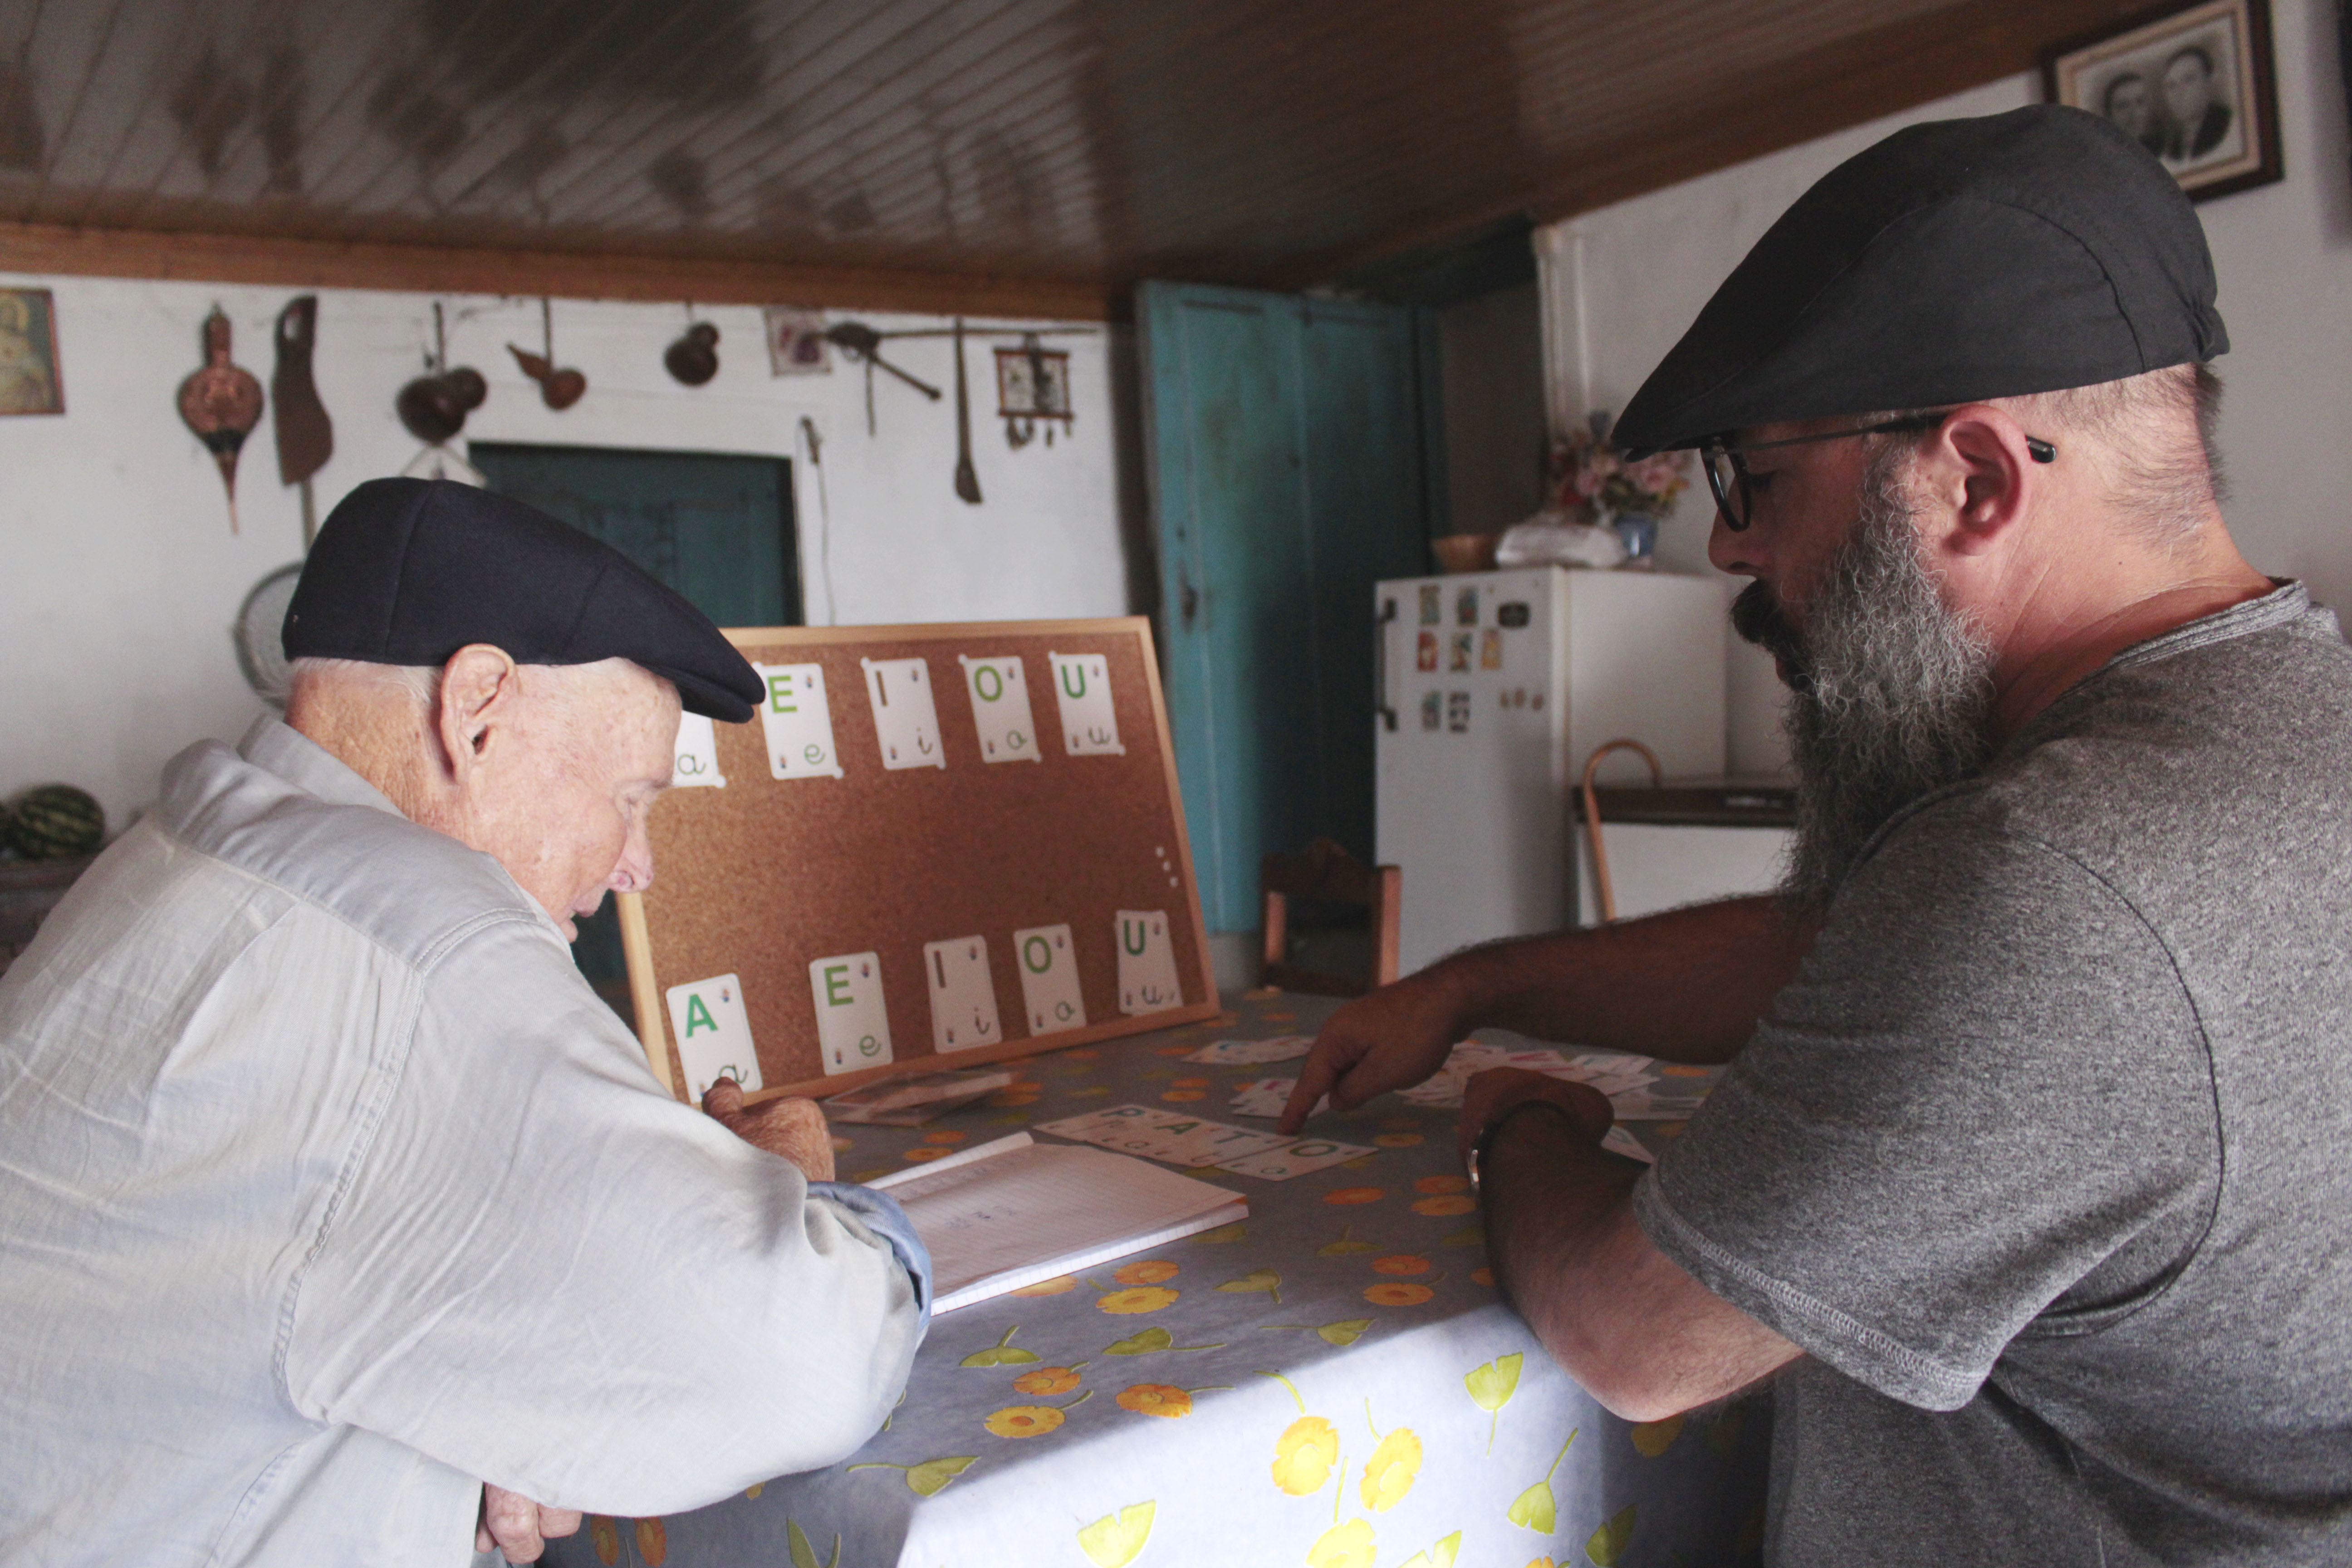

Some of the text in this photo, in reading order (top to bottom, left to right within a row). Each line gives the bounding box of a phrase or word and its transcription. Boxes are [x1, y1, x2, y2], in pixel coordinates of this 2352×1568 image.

[768, 665, 1086, 713] E I O U
[678, 754, 706, 774] a
[804, 744, 825, 764] e
[916, 727, 933, 755] i
[1088, 727, 1111, 745] u
[686, 920, 1145, 1038] A E I O U
[719, 1063, 749, 1084] a
[859, 1035, 881, 1056] e
[974, 1007, 990, 1034] i
